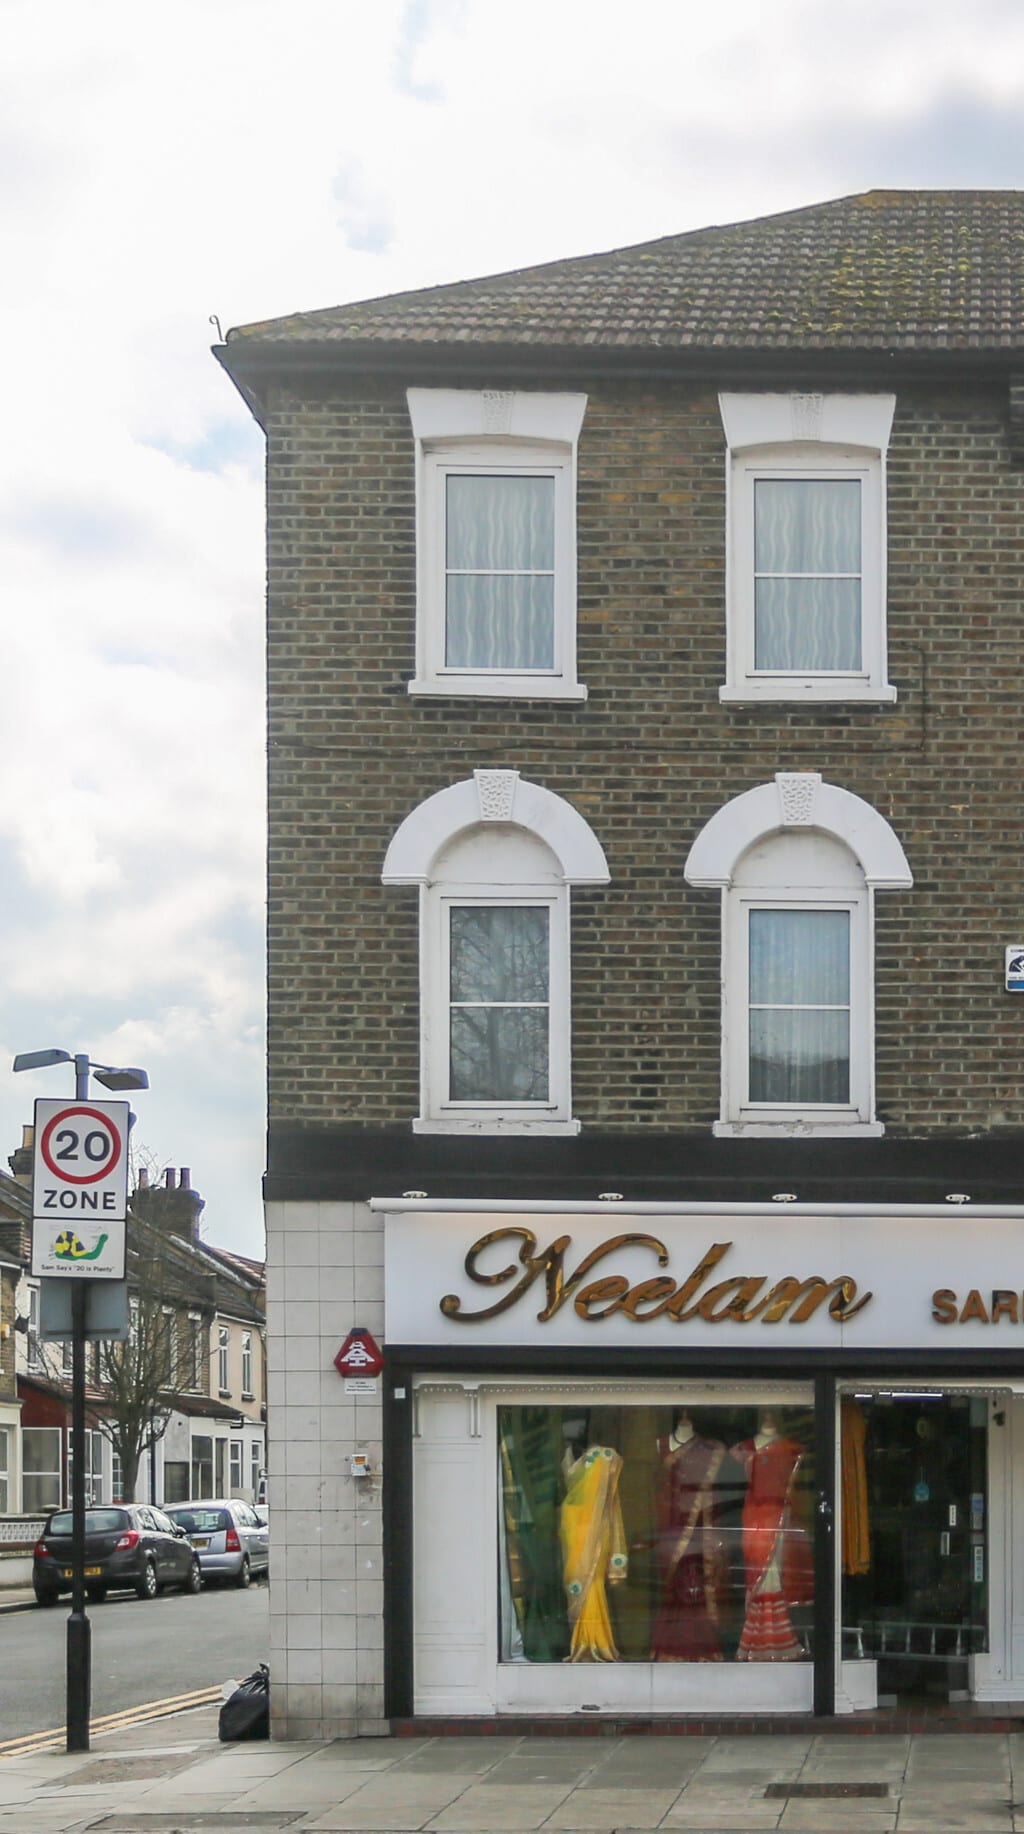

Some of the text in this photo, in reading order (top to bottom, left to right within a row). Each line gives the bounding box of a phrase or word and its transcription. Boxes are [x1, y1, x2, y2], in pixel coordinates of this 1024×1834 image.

[56, 1130, 110, 1162] 20
[43, 1190, 117, 1211] ZONE
[439, 1227, 873, 1323] Neelam
